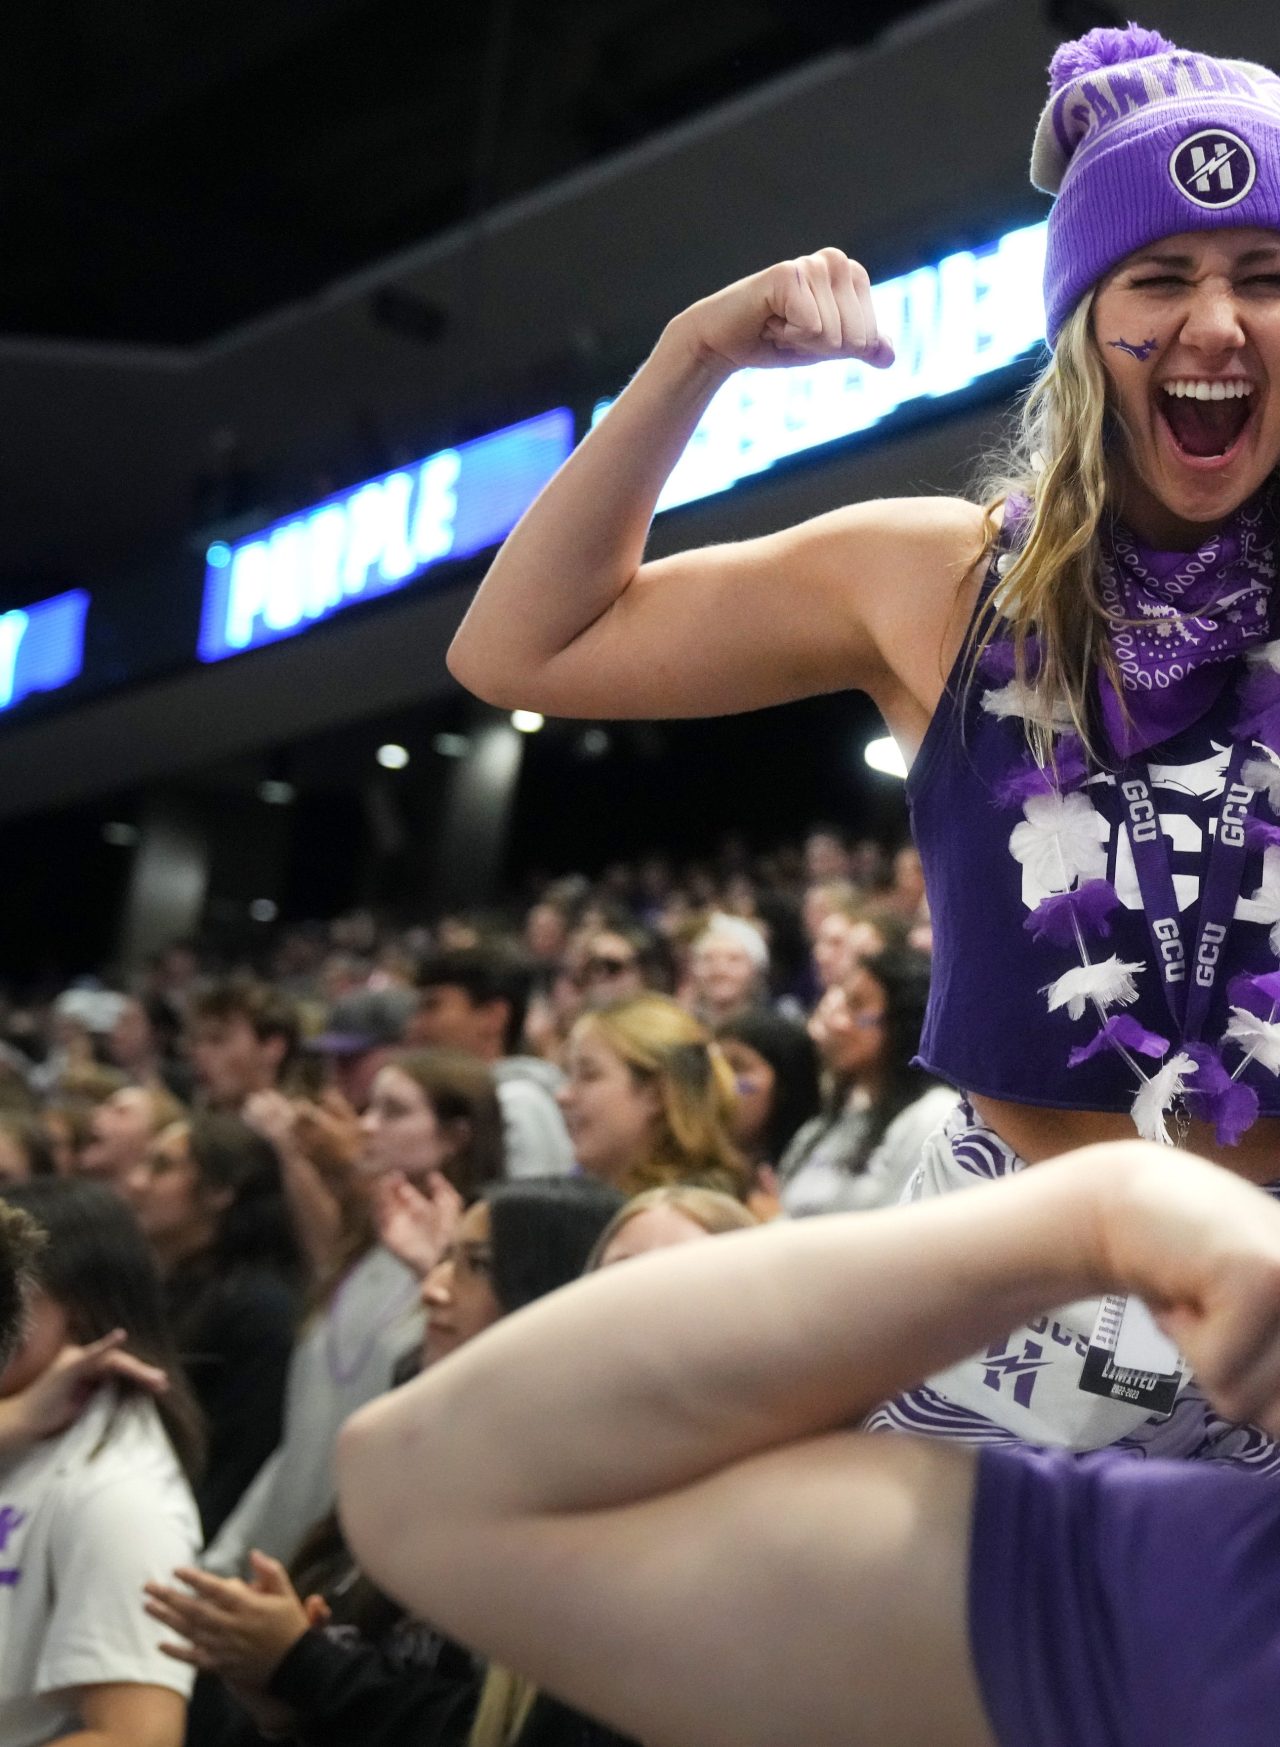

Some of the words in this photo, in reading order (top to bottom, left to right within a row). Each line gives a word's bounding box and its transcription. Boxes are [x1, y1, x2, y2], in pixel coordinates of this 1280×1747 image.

[1120, 778, 1158, 843] GCU
[1220, 782, 1256, 848] GCU
[1151, 916, 1187, 984] GCU
[1195, 921, 1228, 989] GCU
